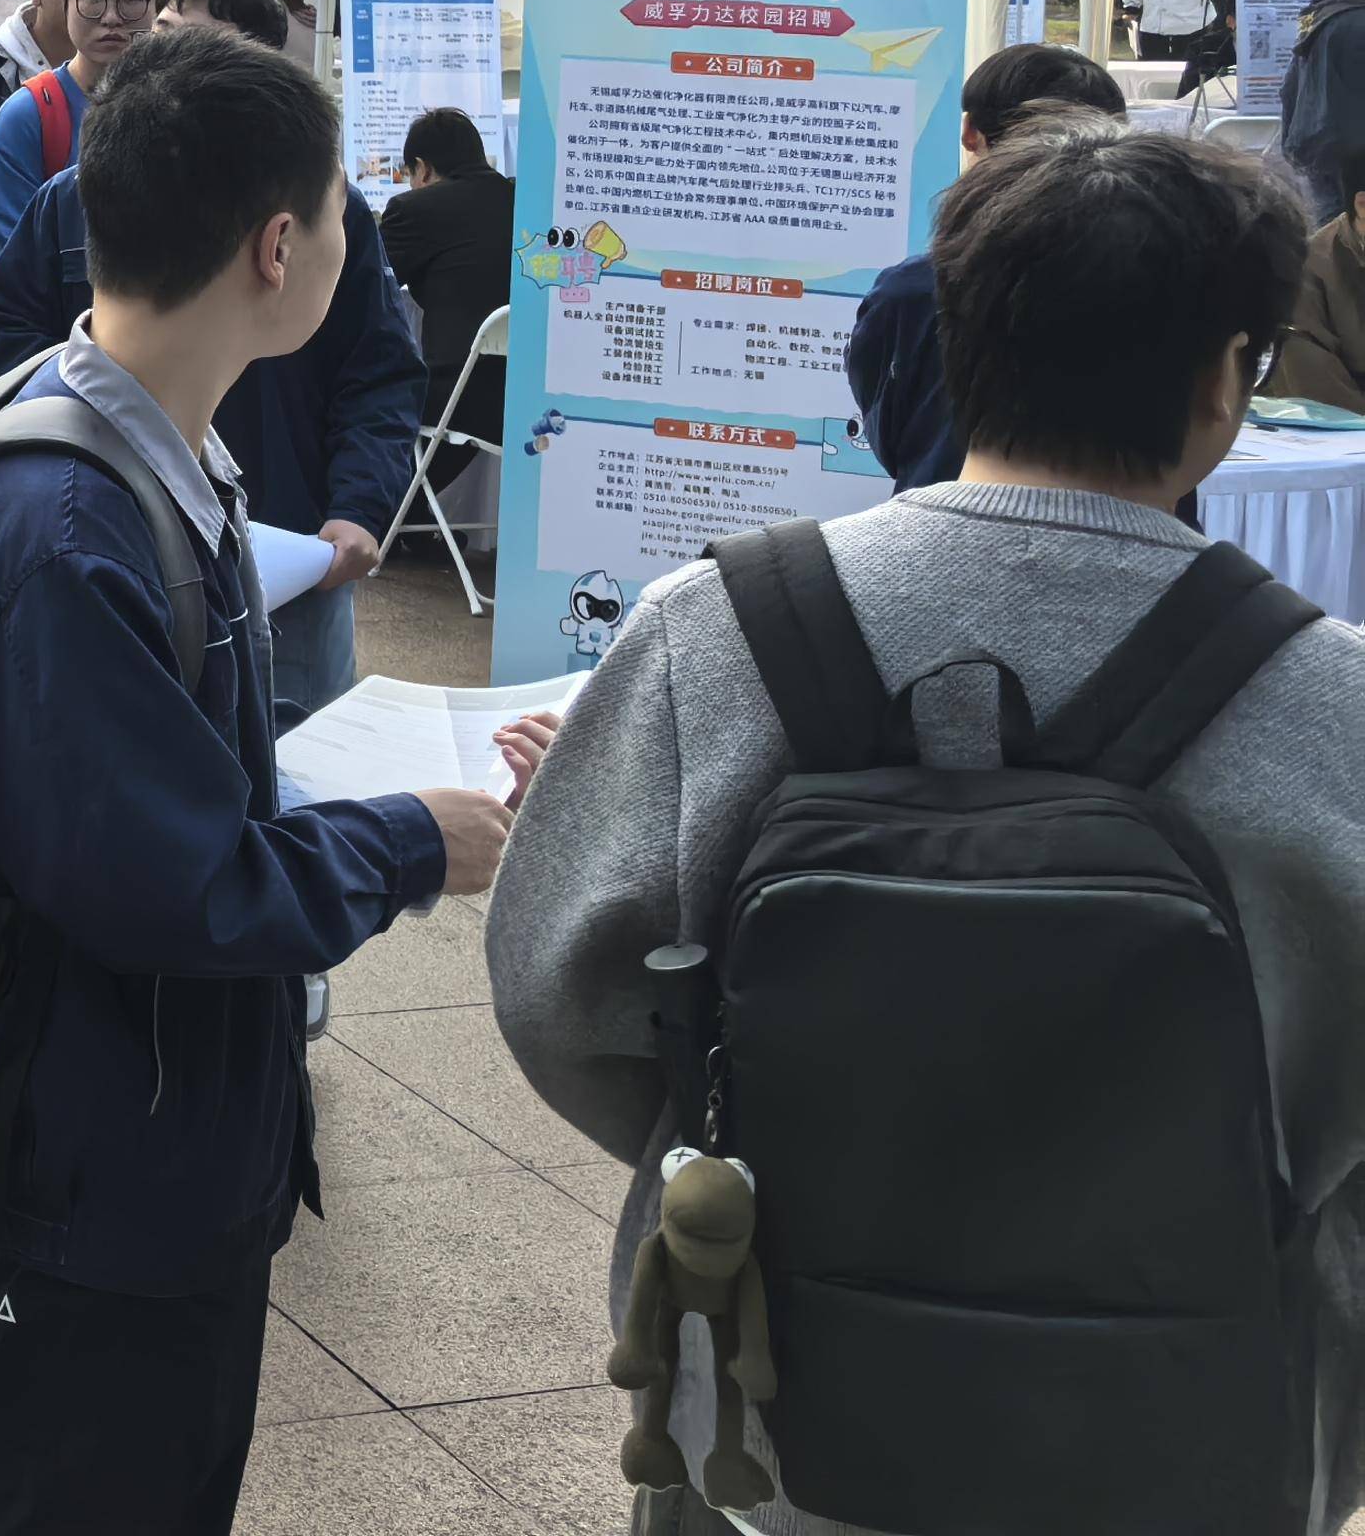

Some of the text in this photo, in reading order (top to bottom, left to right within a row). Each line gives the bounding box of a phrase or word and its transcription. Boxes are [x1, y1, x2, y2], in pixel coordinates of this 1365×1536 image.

[643, 1, 833, 30] 威孚力达校园招聘
[705, 55, 784, 76] 公司简介
[695, 272, 774, 295] 招聘岗位
[688, 421, 766, 446] 联系方式
